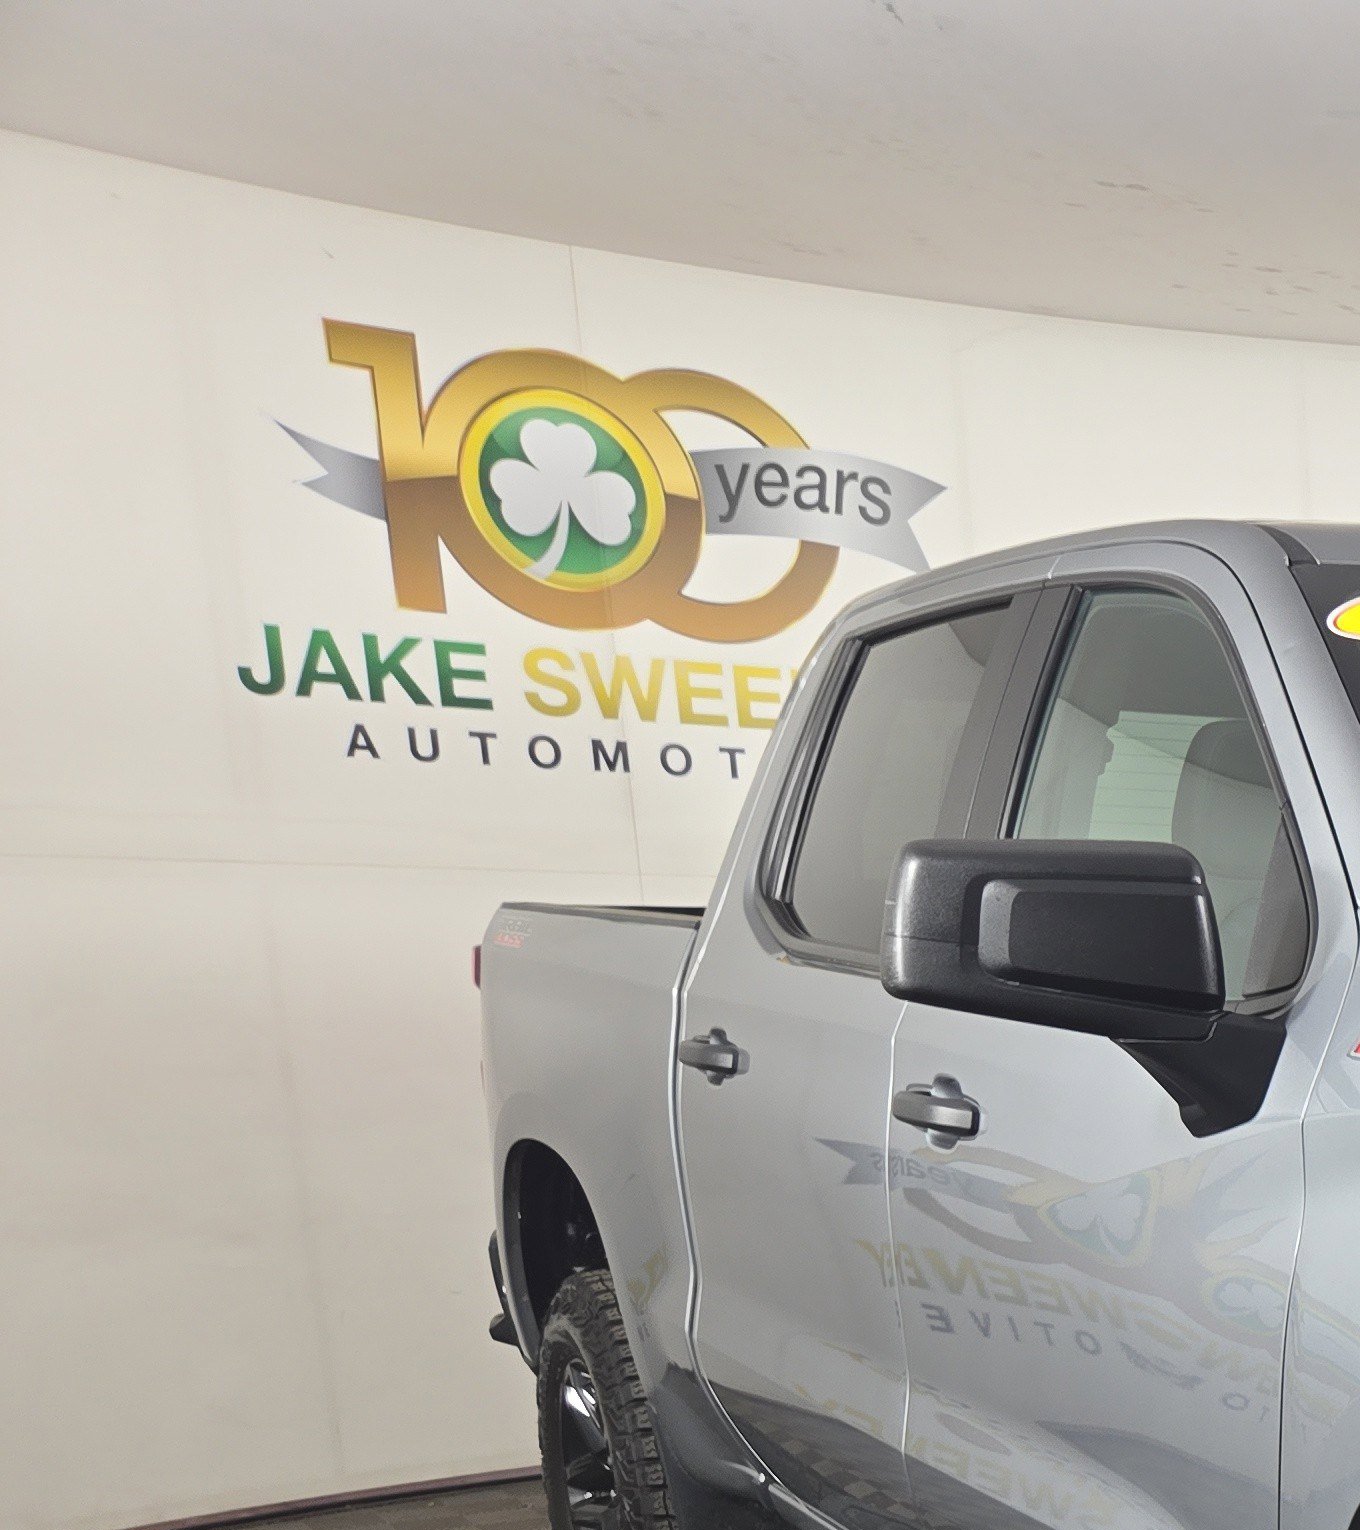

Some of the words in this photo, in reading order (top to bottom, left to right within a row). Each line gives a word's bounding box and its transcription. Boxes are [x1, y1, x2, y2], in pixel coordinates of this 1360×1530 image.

[713, 460, 893, 527] years
[237, 622, 494, 712] JAKE
[521, 647, 800, 731] SWEE
